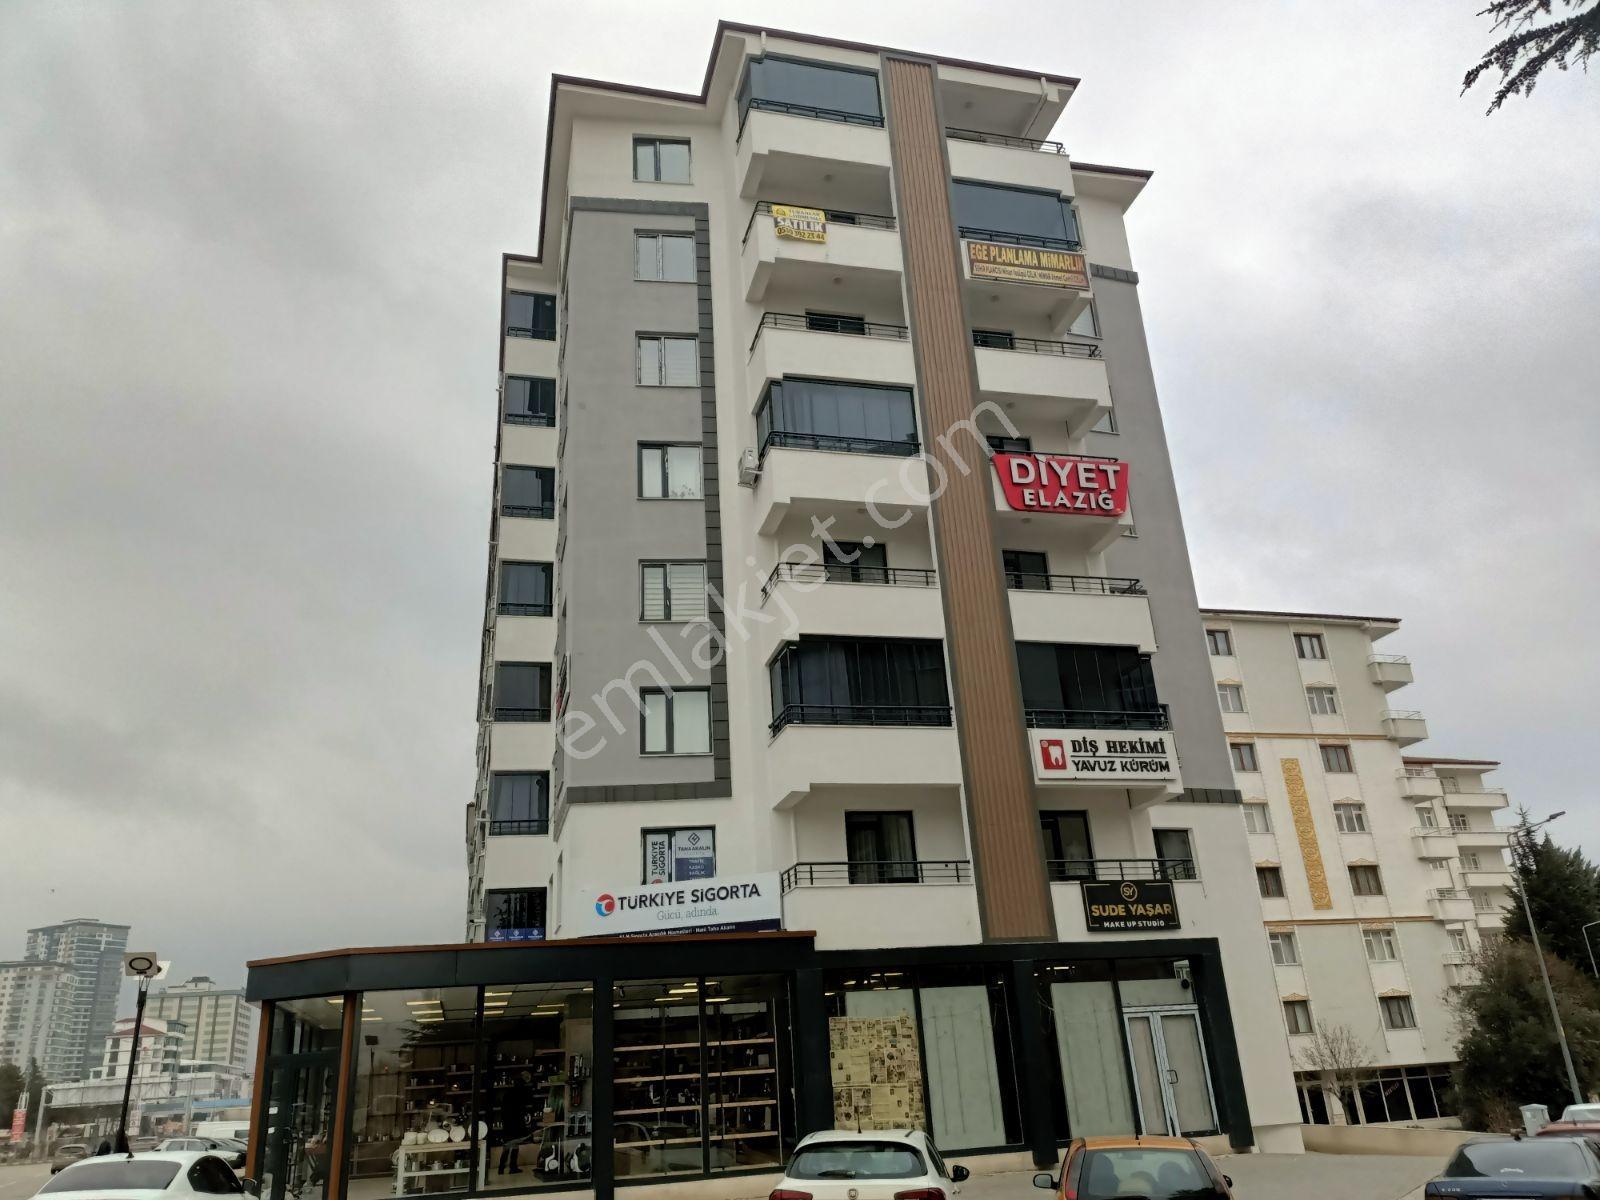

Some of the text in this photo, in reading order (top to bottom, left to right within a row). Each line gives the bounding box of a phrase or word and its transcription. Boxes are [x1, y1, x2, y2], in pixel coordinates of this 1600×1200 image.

[777, 217, 823, 232] SATILIK
[970, 243, 988, 260] EGE
[990, 246, 1038, 266] PLANLAMA
[1009, 456, 1120, 490] DİYET
[1023, 488, 1115, 510] ELAZIĞ
[1070, 736, 1167, 756] DİŞ HEKİMİ
[1072, 759, 1170, 772] YAVUZ KÜRÜM
[618, 883, 761, 911] TÜRKİYE SİGORTA
[1091, 903, 1172, 917] SUDE YAŞAR
